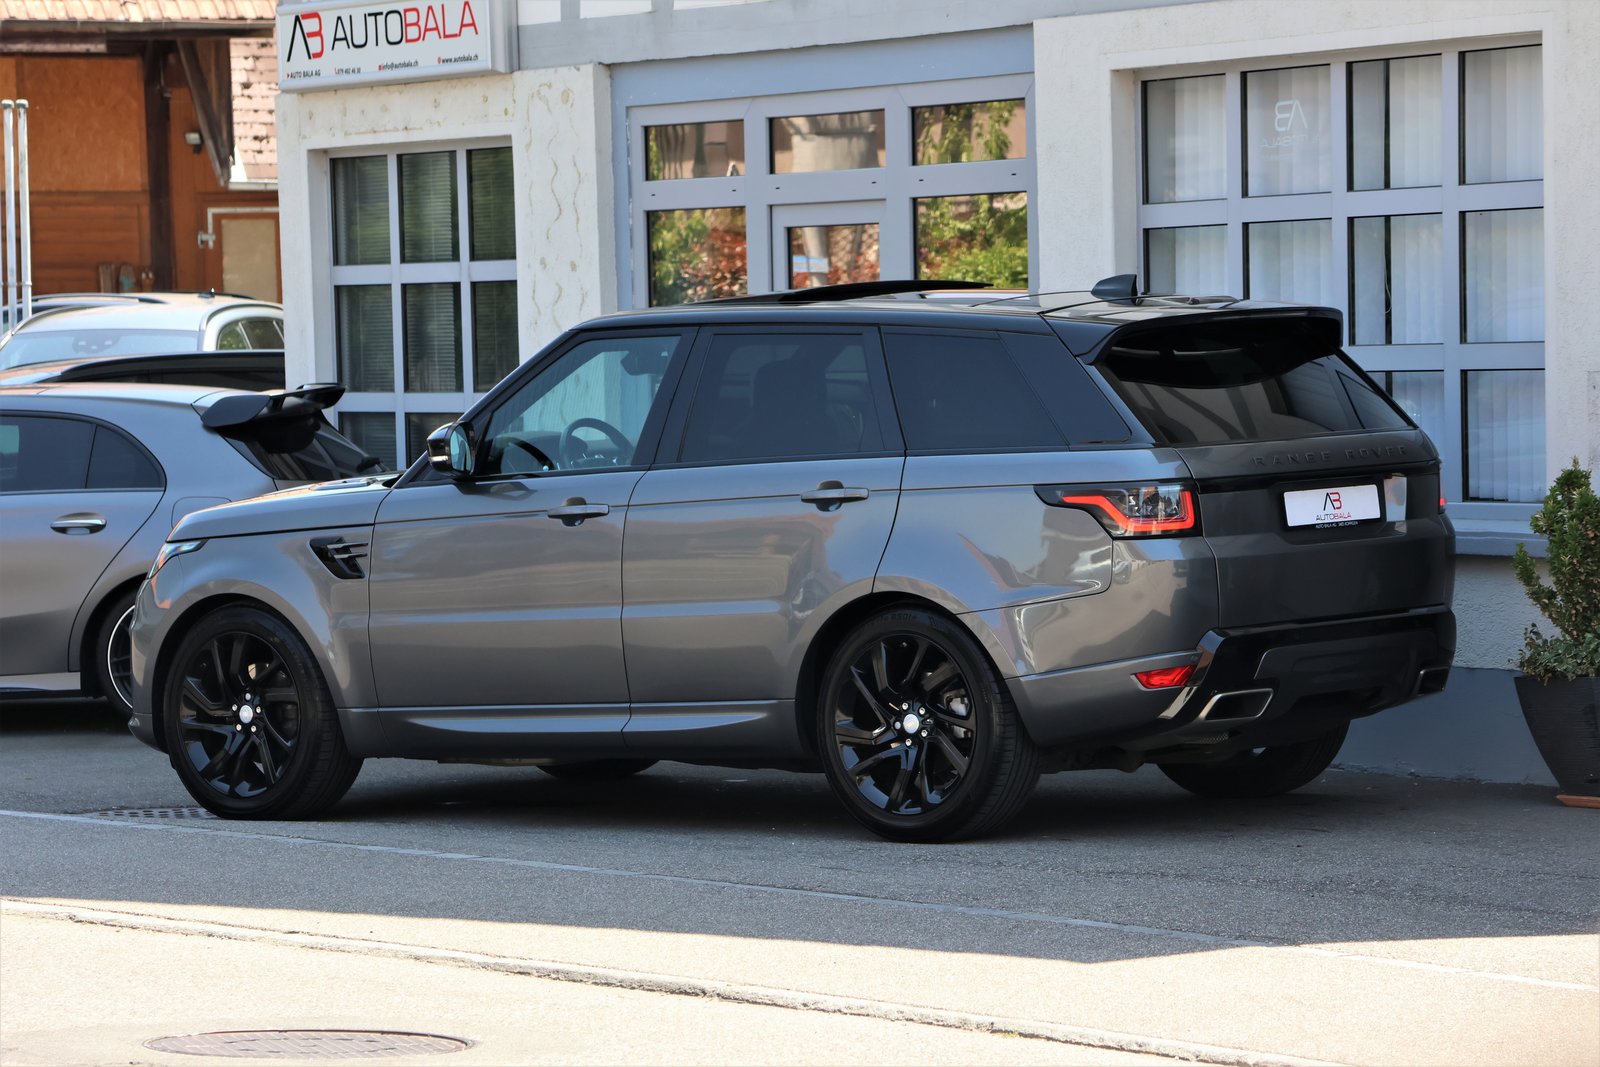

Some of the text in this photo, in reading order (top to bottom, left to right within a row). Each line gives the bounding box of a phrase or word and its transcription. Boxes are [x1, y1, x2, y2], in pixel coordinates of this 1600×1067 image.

[331, 0, 479, 51] AUTOBALA
[441, 53, 479, 64] www.autobala.ch
[382, 59, 419, 70] info@autobala.ch
[290, 68, 321, 79] AUTO BALA AG
[1315, 512, 1352, 521] AUTOBALA
